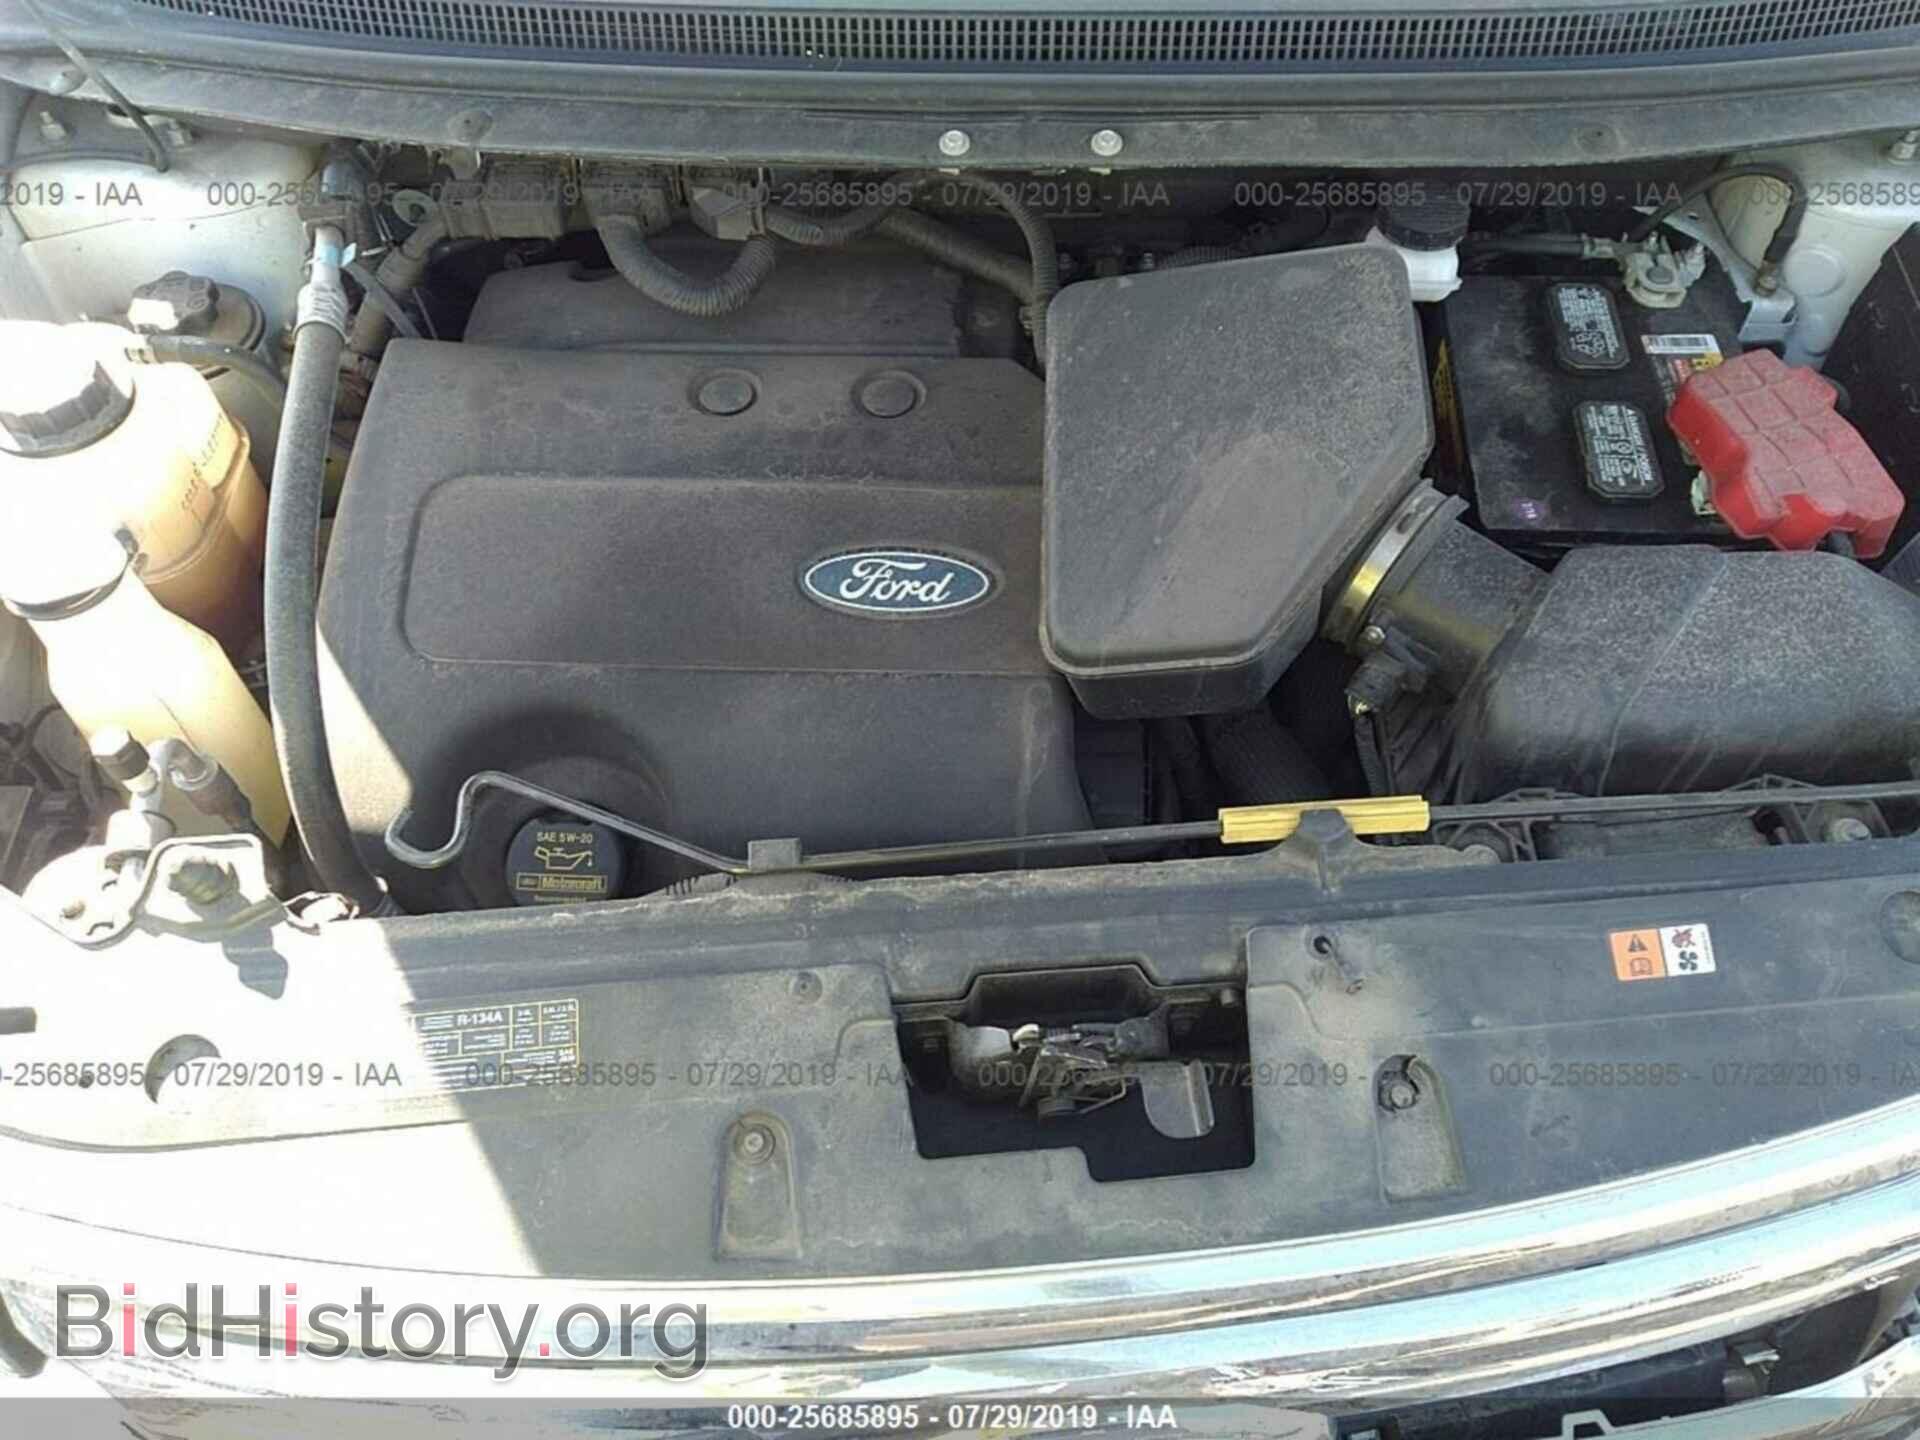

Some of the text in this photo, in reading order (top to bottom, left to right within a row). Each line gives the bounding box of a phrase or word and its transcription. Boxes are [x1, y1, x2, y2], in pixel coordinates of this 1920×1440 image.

[839, 558, 955, 603] Ford
[536, 831, 593, 844] SAE 5W-20
[456, 1010, 503, 1026] R-134A
